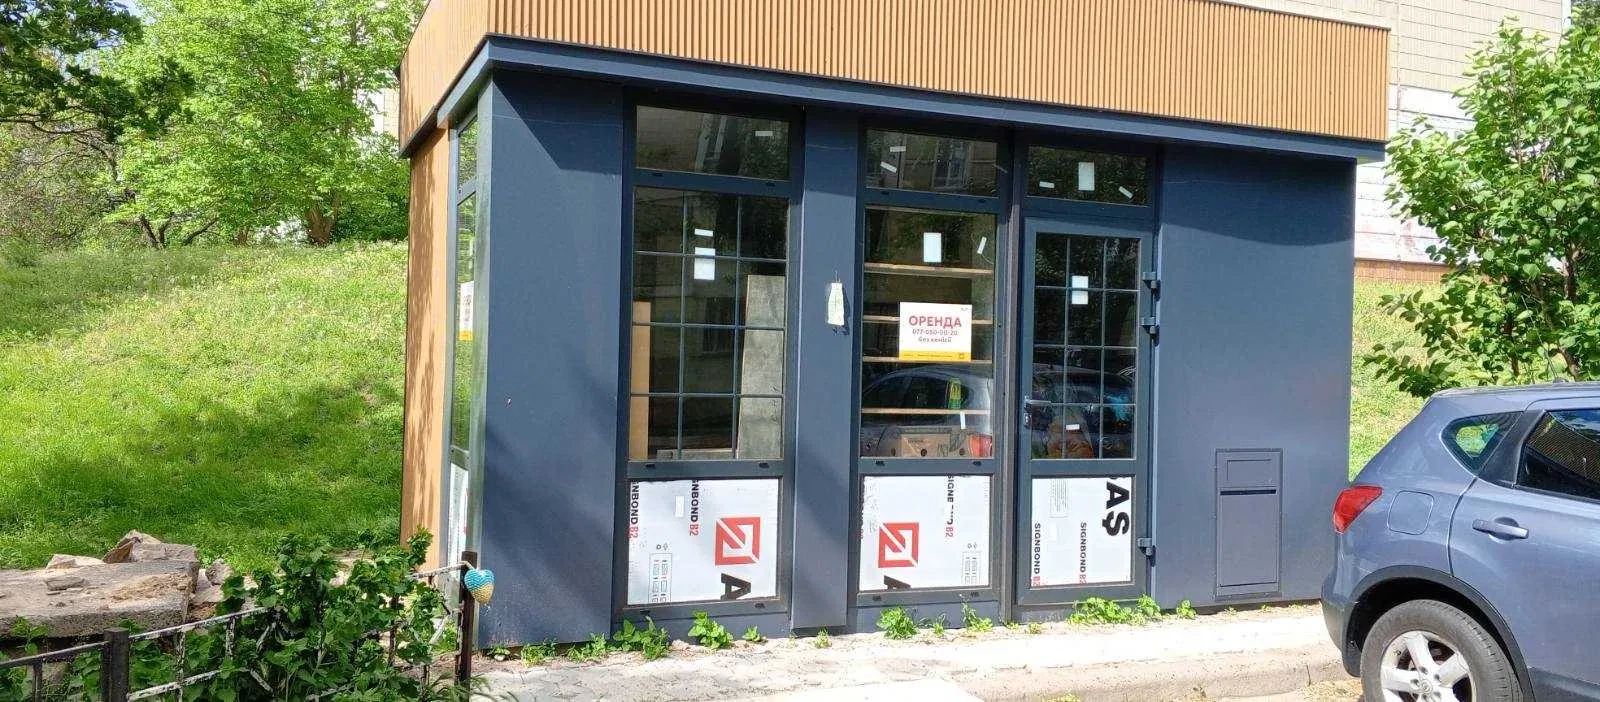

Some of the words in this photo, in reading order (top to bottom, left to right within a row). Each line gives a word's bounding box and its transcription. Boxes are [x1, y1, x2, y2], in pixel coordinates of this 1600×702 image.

[908, 315, 962, 329] ОРЕНДА
[1102, 479, 1130, 536] AŞ
[689, 524, 699, 536] B2
[945, 526, 954, 538] B2
[1033, 522, 1041, 575] SIGNBOND
